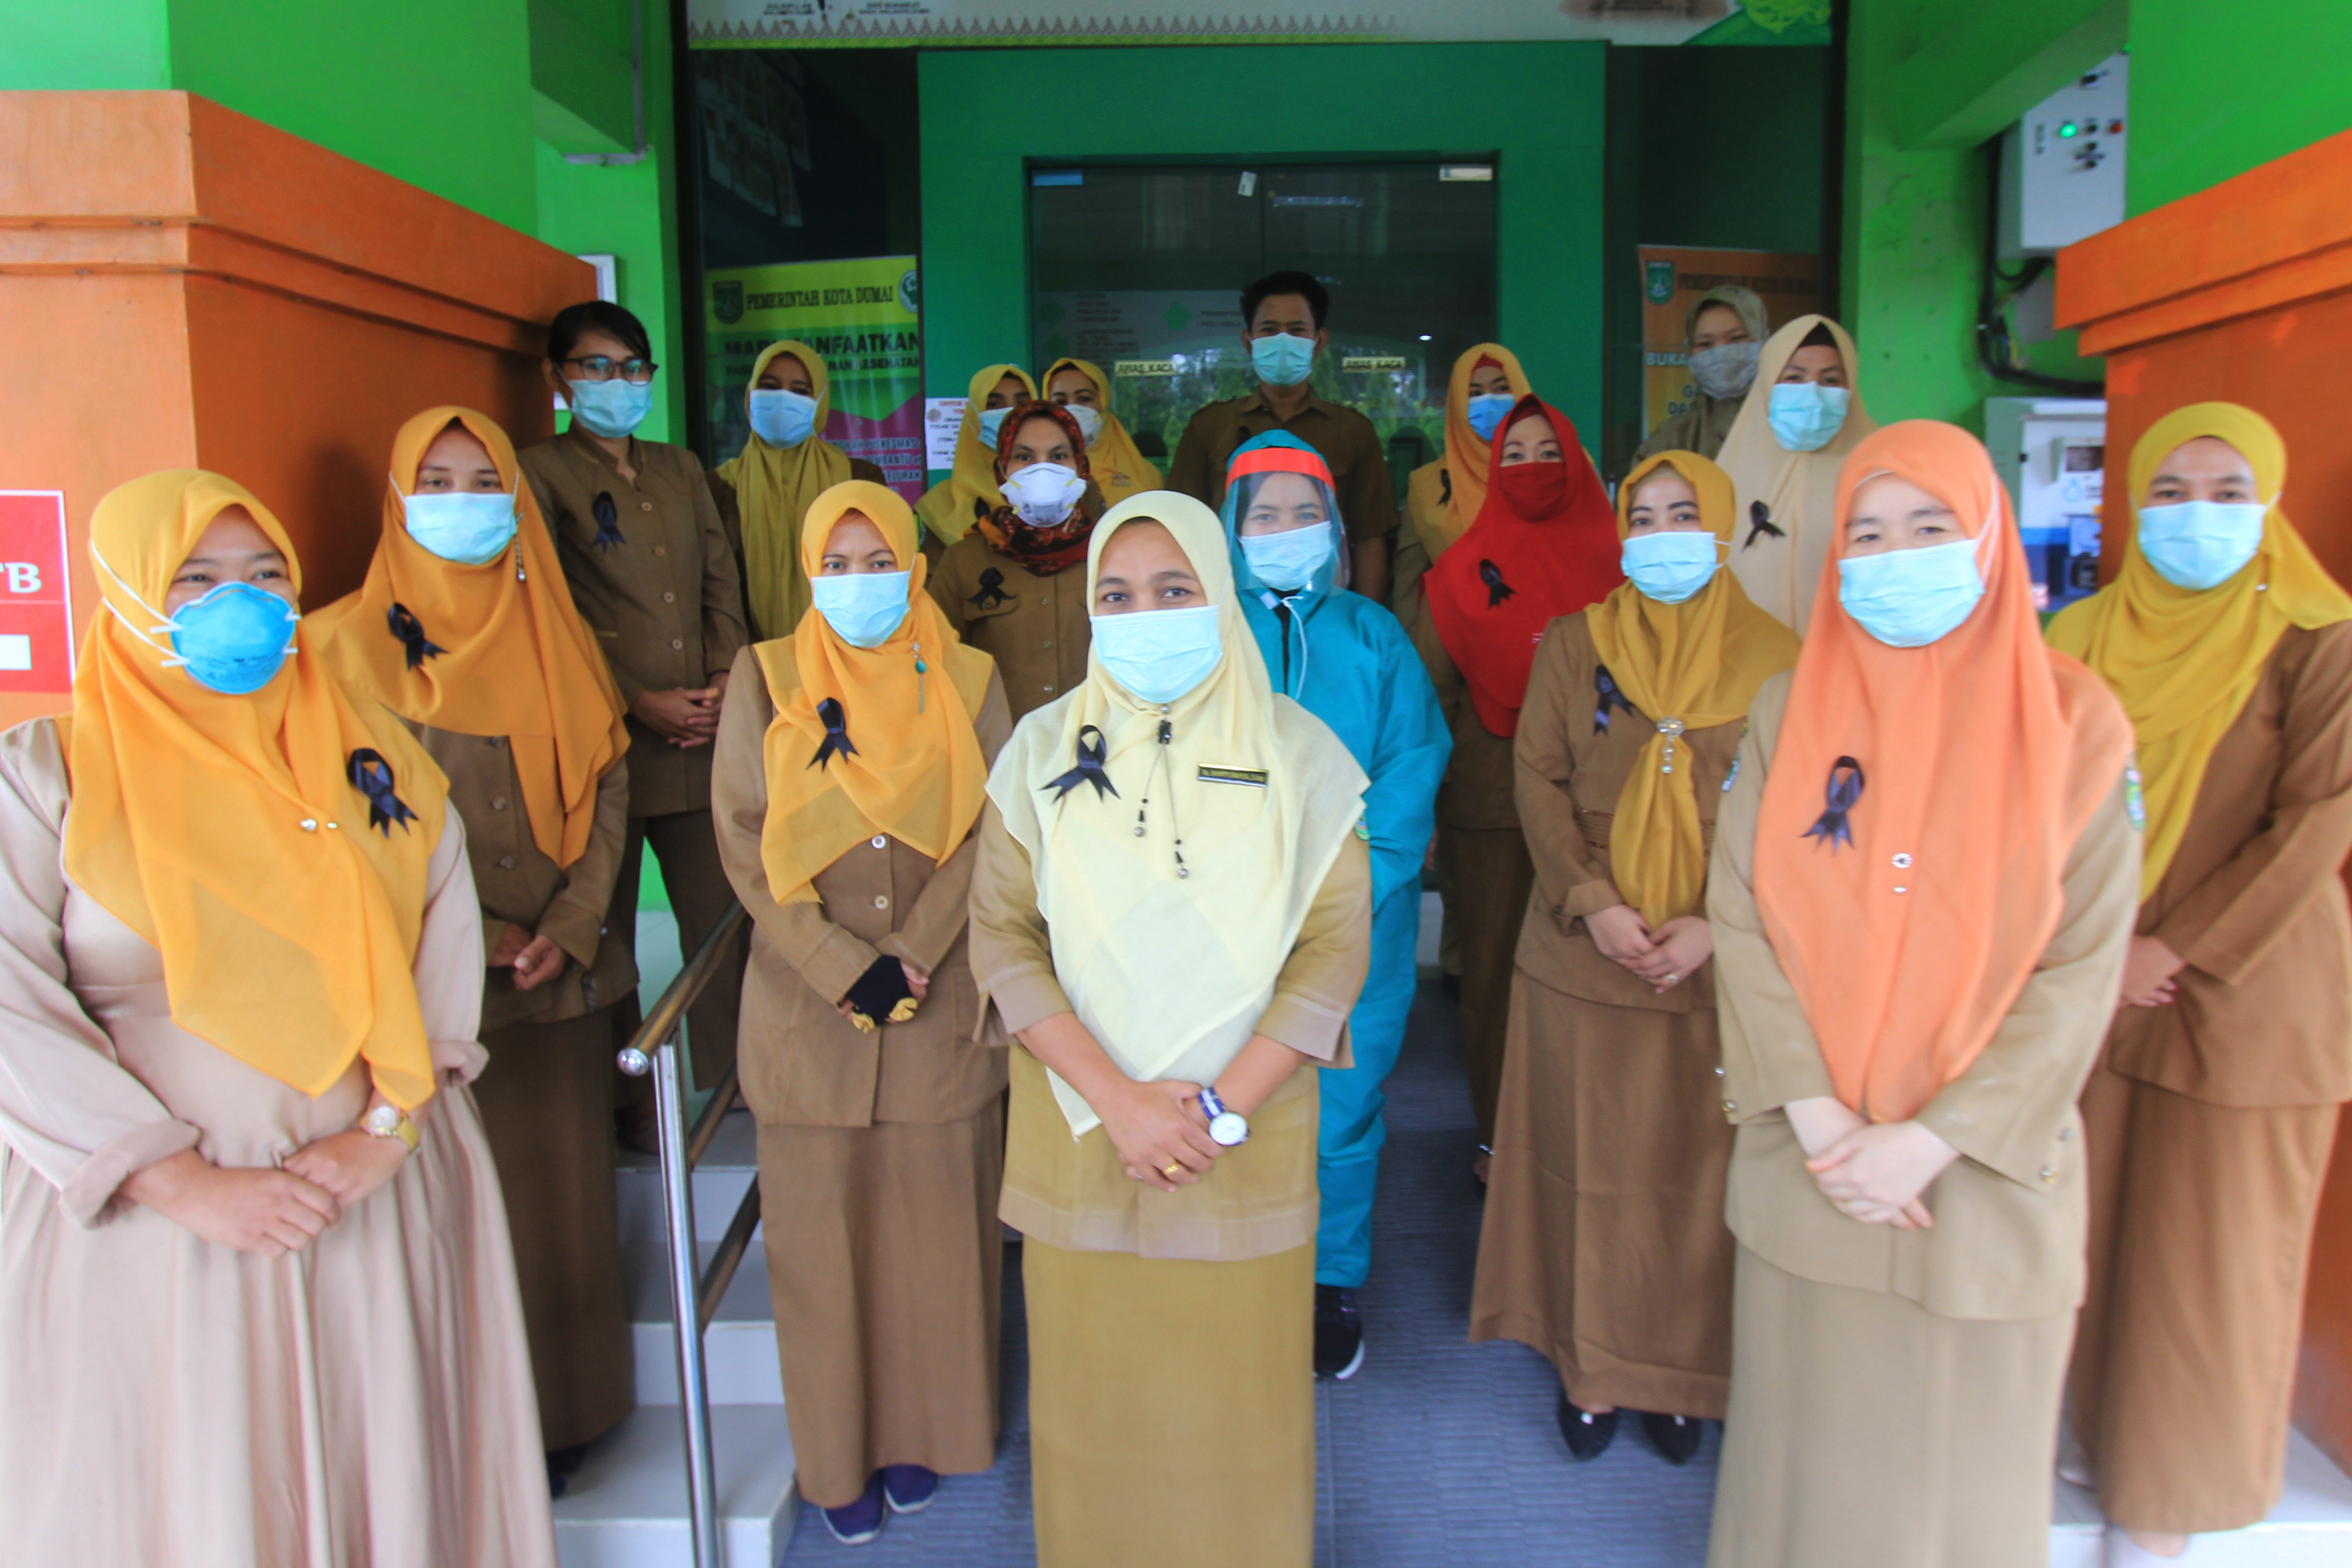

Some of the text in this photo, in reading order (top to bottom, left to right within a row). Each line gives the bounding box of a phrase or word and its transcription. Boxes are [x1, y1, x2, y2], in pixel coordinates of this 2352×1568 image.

[747, 285, 893, 310] PEMERINTAH KOTA DUMAI
[724, 331, 918, 354] MAR ANFAATKAN
[1149, 363, 1172, 372] KACA
[0, 562, 42, 593] B
